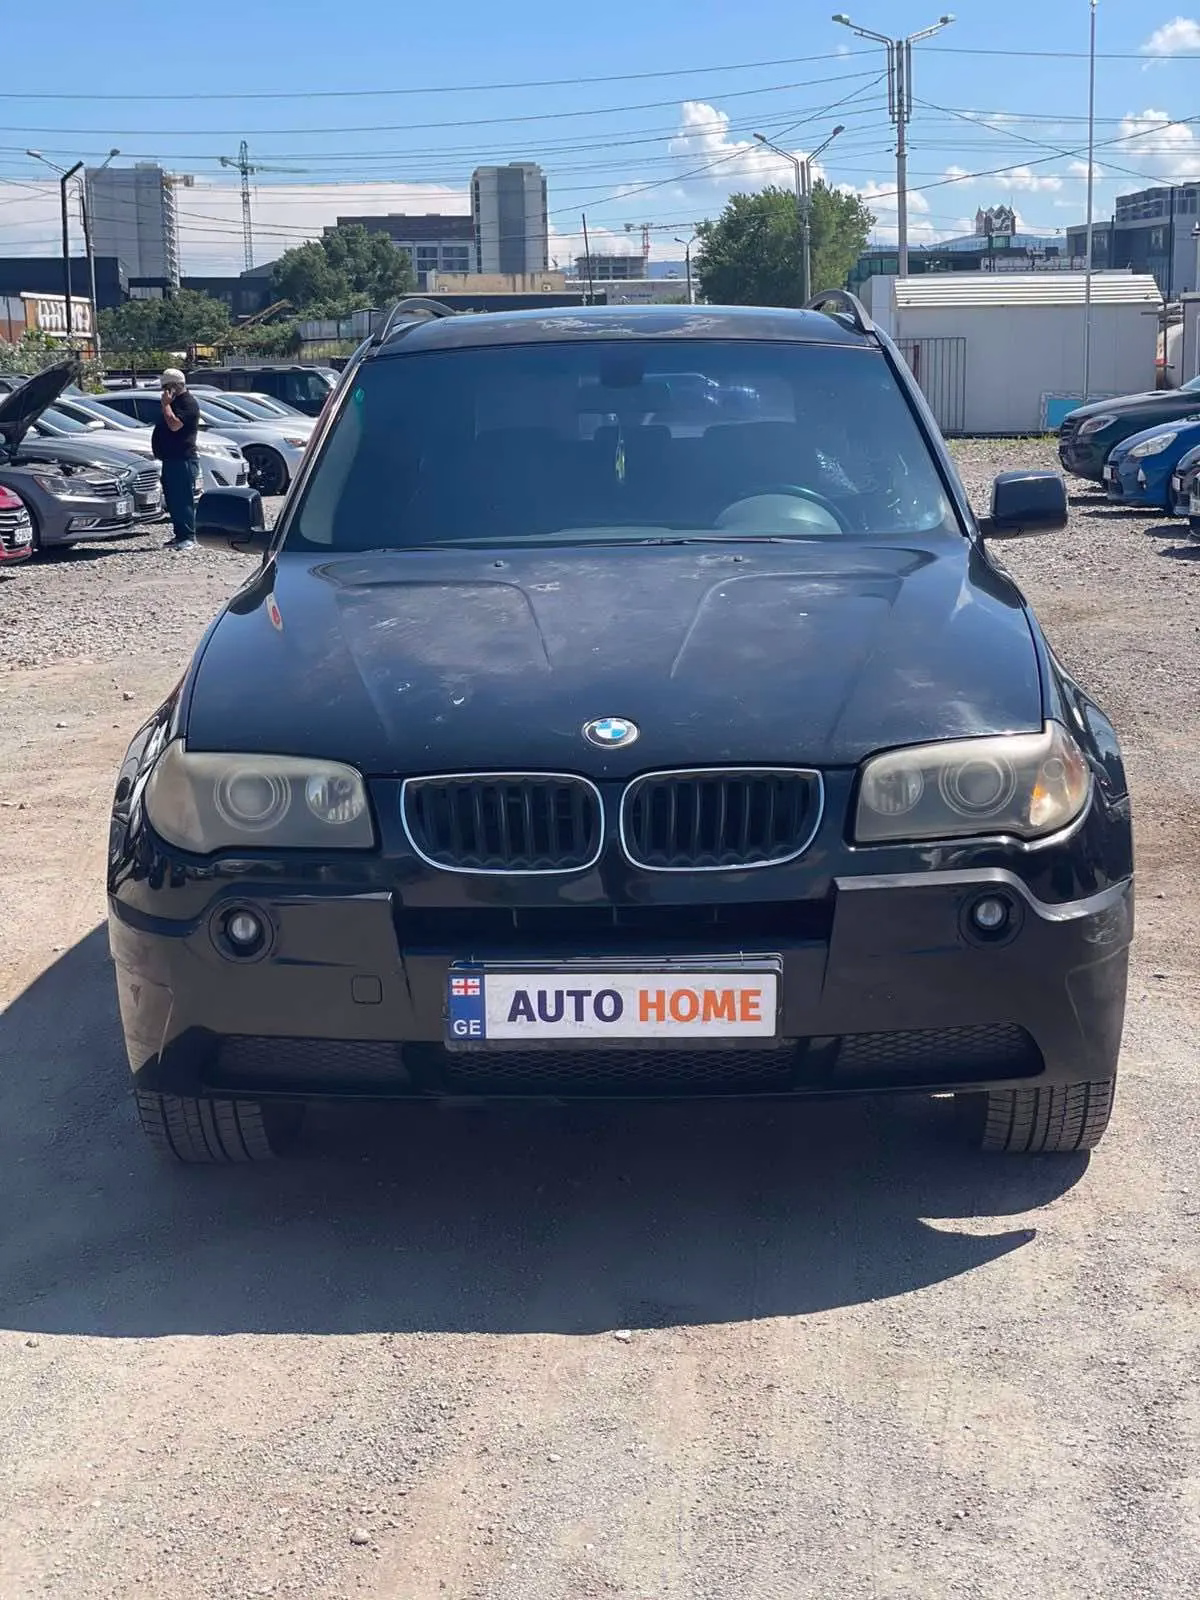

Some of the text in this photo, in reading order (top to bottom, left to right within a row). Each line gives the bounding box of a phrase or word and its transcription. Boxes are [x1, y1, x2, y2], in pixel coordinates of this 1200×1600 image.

[507, 989, 762, 1023] AUTO HOME
[453, 1019, 481, 1035] GE
